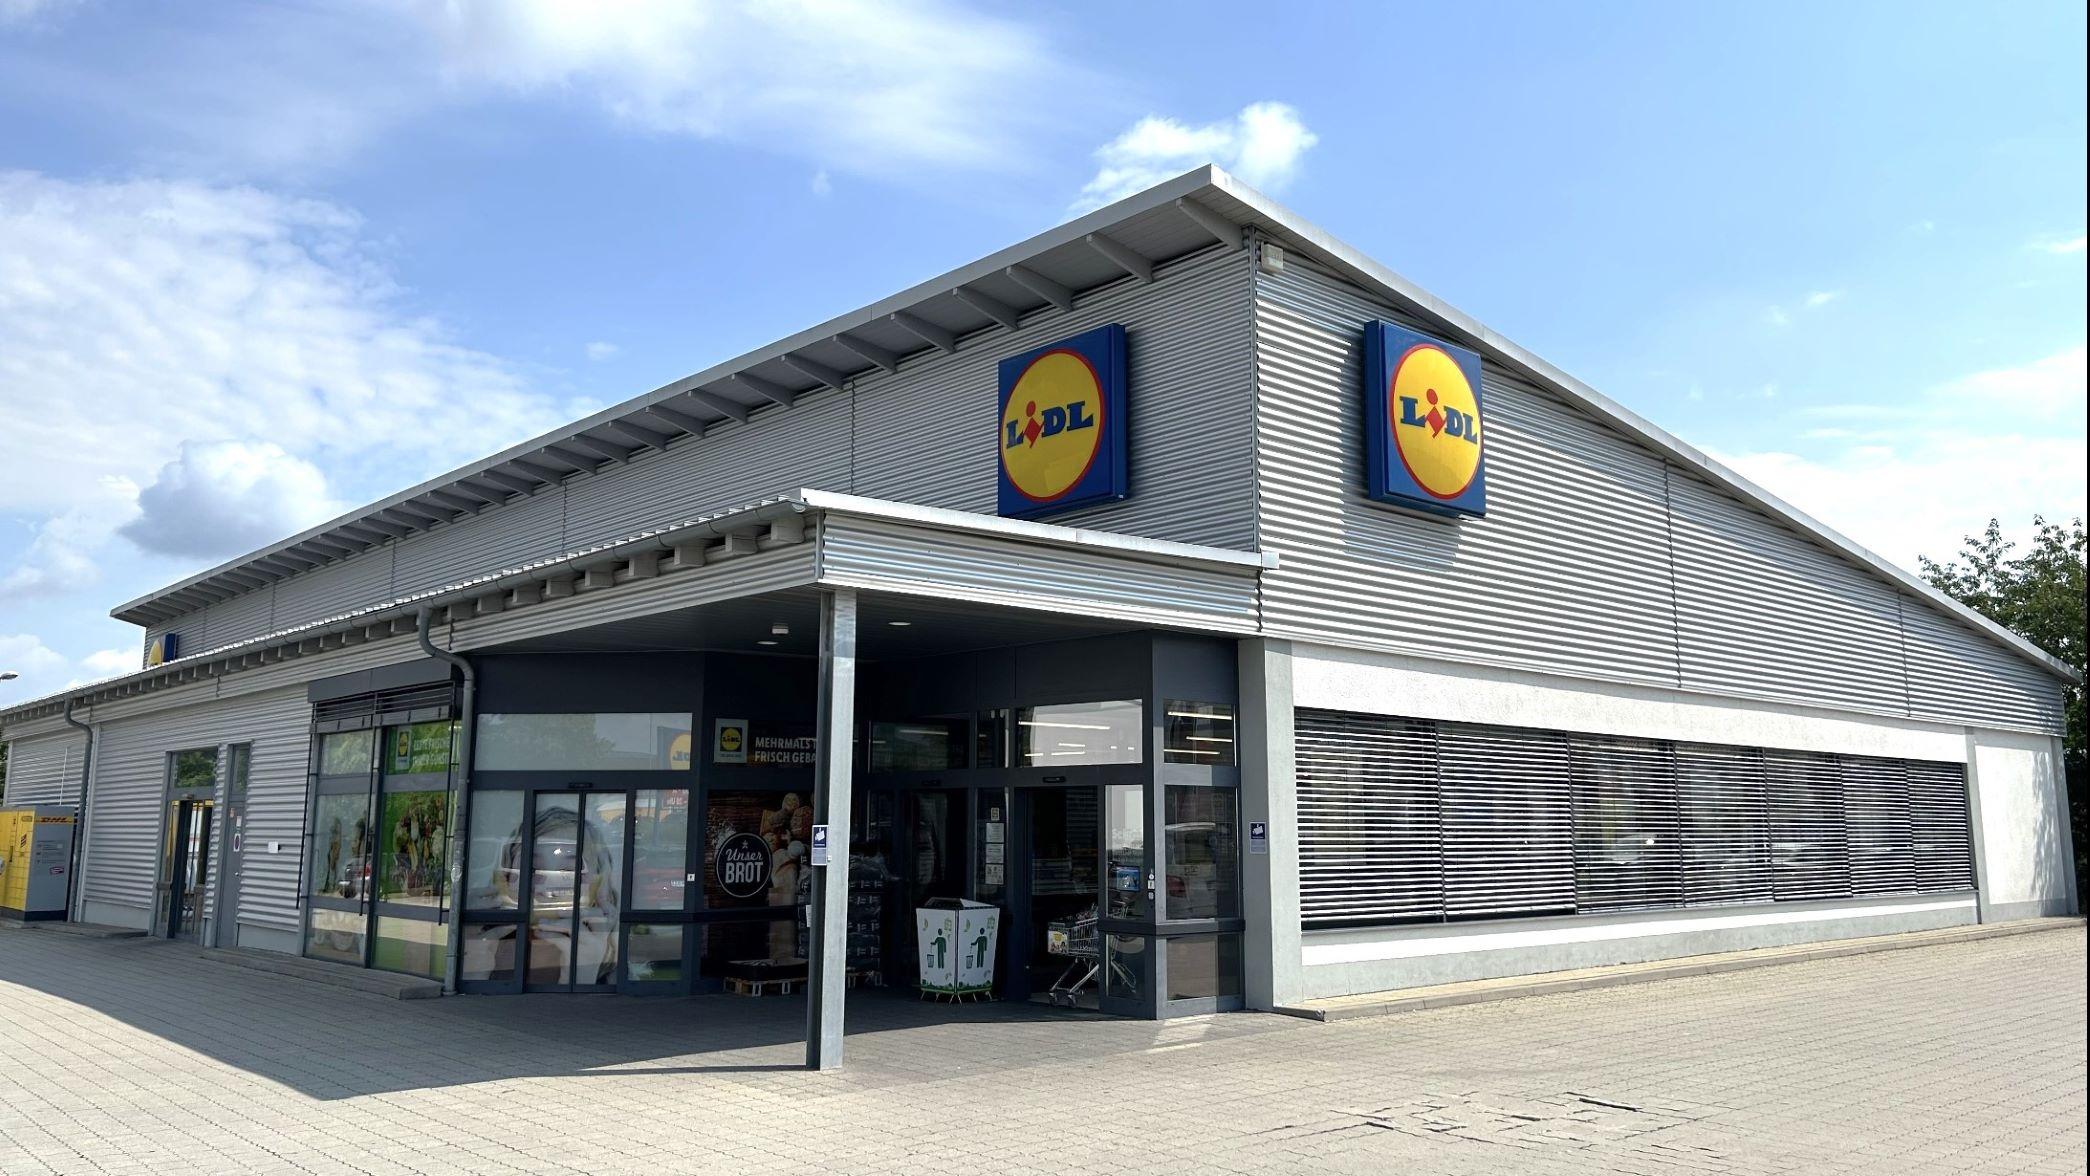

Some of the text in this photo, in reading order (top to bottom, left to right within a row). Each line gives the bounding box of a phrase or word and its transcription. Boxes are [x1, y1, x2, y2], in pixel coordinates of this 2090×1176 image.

[755, 737, 811, 750] MEHRMALS
[754, 750, 790, 763] FRISCH
[792, 752, 816, 763] GEBA
[725, 848, 763, 861] Unser
[725, 861, 764, 883] BROT
